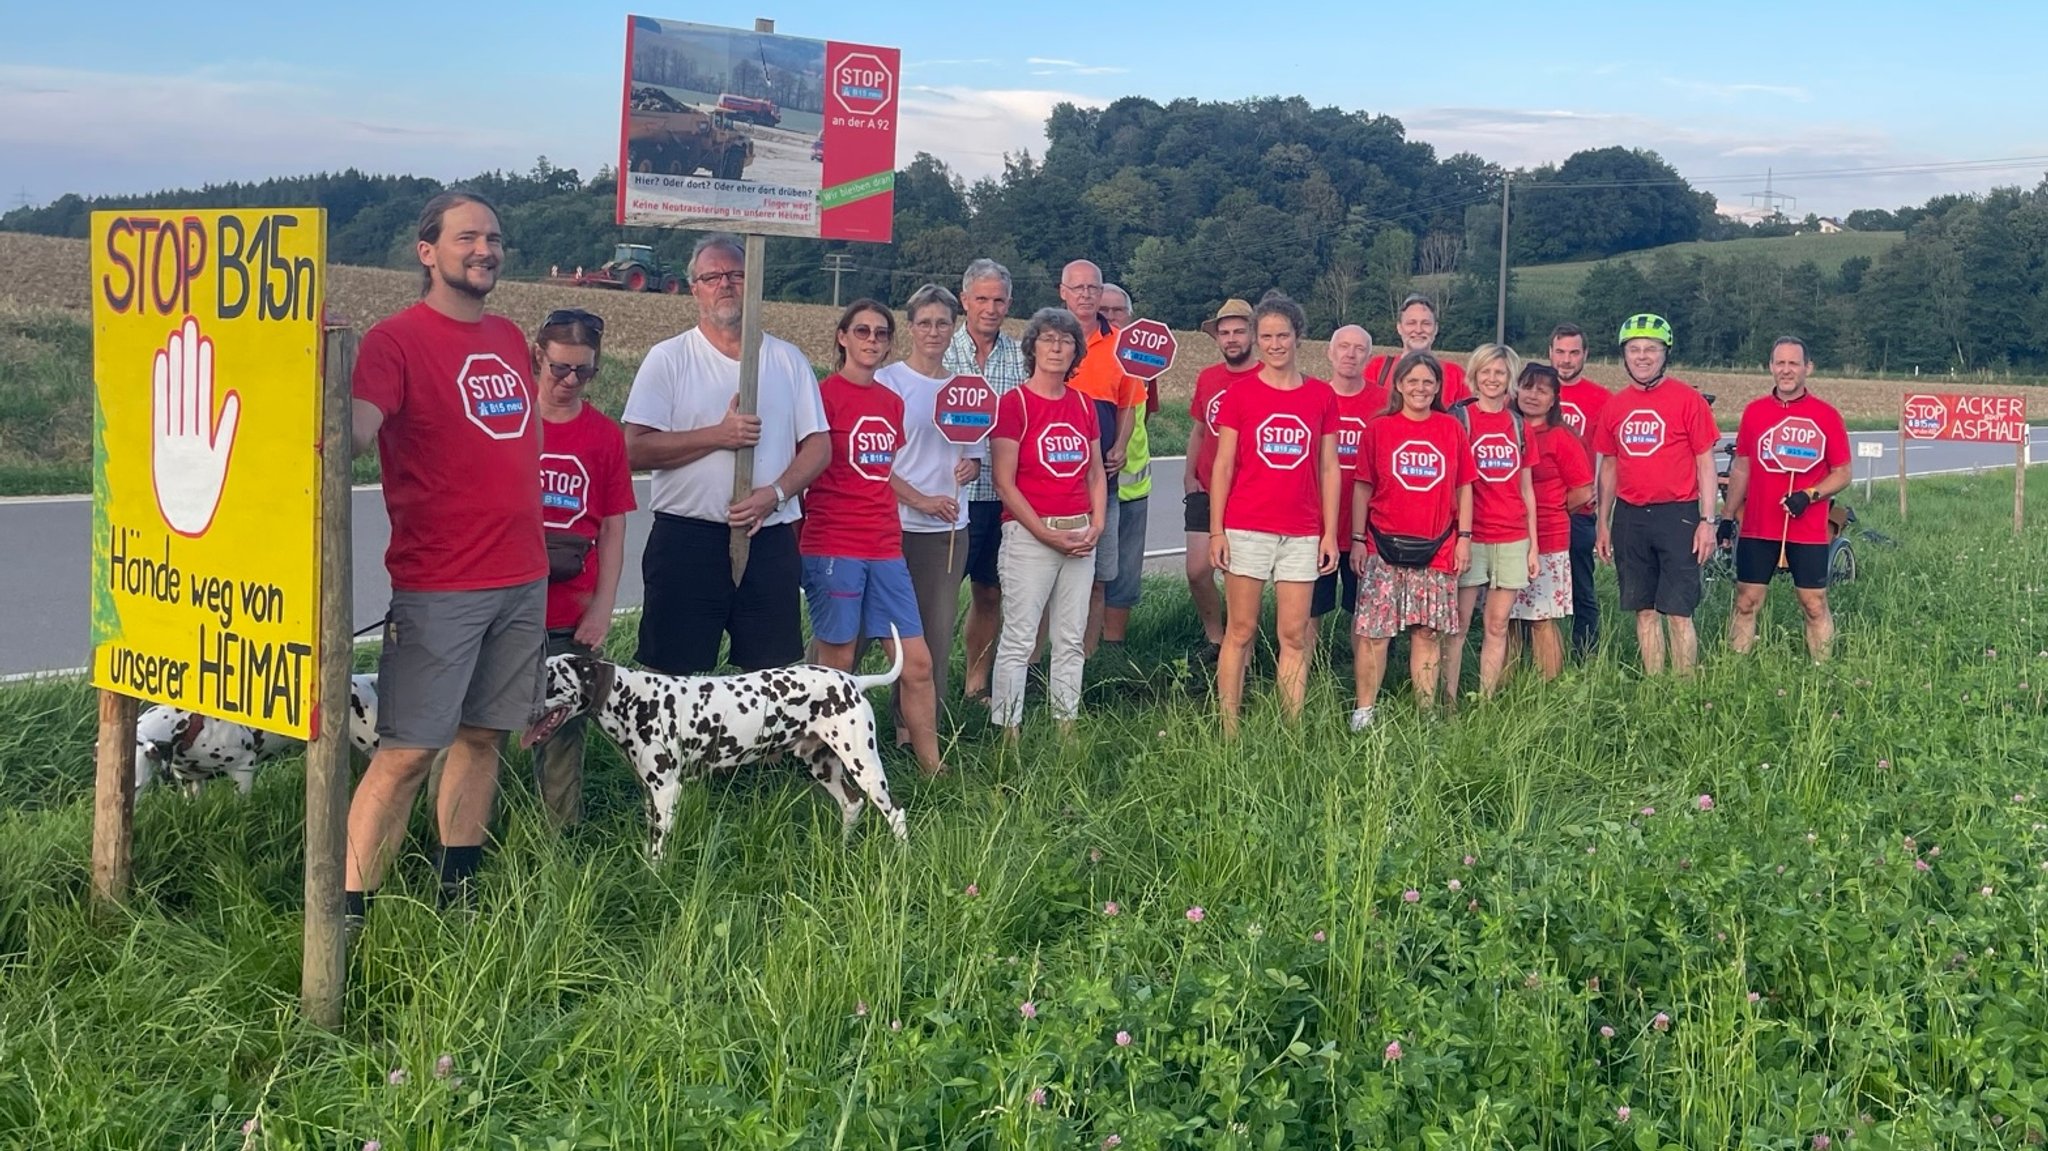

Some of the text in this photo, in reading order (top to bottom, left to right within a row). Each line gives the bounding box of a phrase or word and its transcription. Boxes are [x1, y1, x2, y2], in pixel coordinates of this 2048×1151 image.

[841, 68, 884, 88] STOP
[832, 117, 889, 131] an der A 92
[635, 176, 812, 198] Hier? Oder dort? Oder eher dort drüben?
[823, 190, 838, 201] Wir
[840, 181, 871, 197] bleiben
[632, 200, 811, 221] Keine Neutrassierung in unserer Heimat!
[763, 198, 790, 209] Finger
[103, 215, 315, 321] STOP B15n
[1130, 329, 1168, 350] STOP
[468, 373, 517, 400] STOP
[947, 386, 988, 407] STOP
[490, 402, 523, 413] B15 neu
[1905, 403, 1944, 420] STOP
[1956, 396, 2025, 417] ACKER
[1263, 426, 1305, 444] STOP
[1624, 421, 1659, 435] STOP
[1781, 426, 1816, 444] STOP
[1951, 419, 2026, 441] ASPHALT
[858, 432, 895, 451] STOP
[1045, 436, 1082, 451] STOP
[1399, 451, 1438, 467] STOP
[1477, 445, 1514, 460] STOP
[544, 495, 579, 508] B15 neu
[110, 525, 283, 629] Hände weg von
[110, 623, 312, 727] unserer HEIMAT
